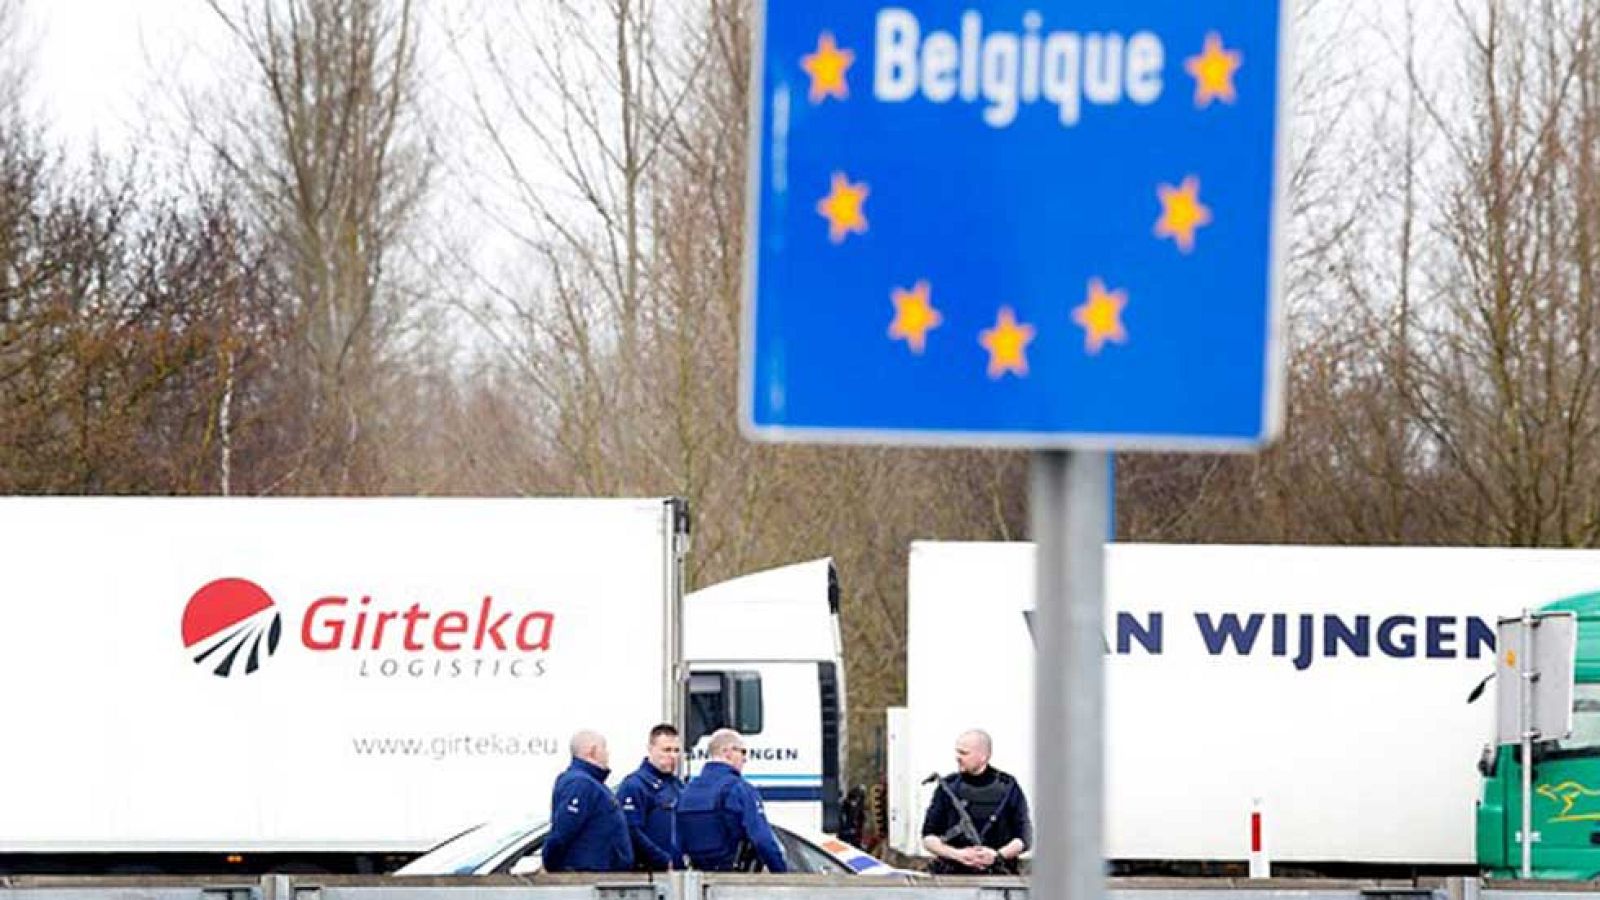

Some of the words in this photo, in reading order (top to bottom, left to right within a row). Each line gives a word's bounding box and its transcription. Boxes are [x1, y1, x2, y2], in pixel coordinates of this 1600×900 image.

[874, 8, 1164, 127] Belgique
[300, 595, 555, 653] Girteka
[359, 659, 545, 677] LOGISTICS
[352, 733, 558, 760] www.girteka.eu
